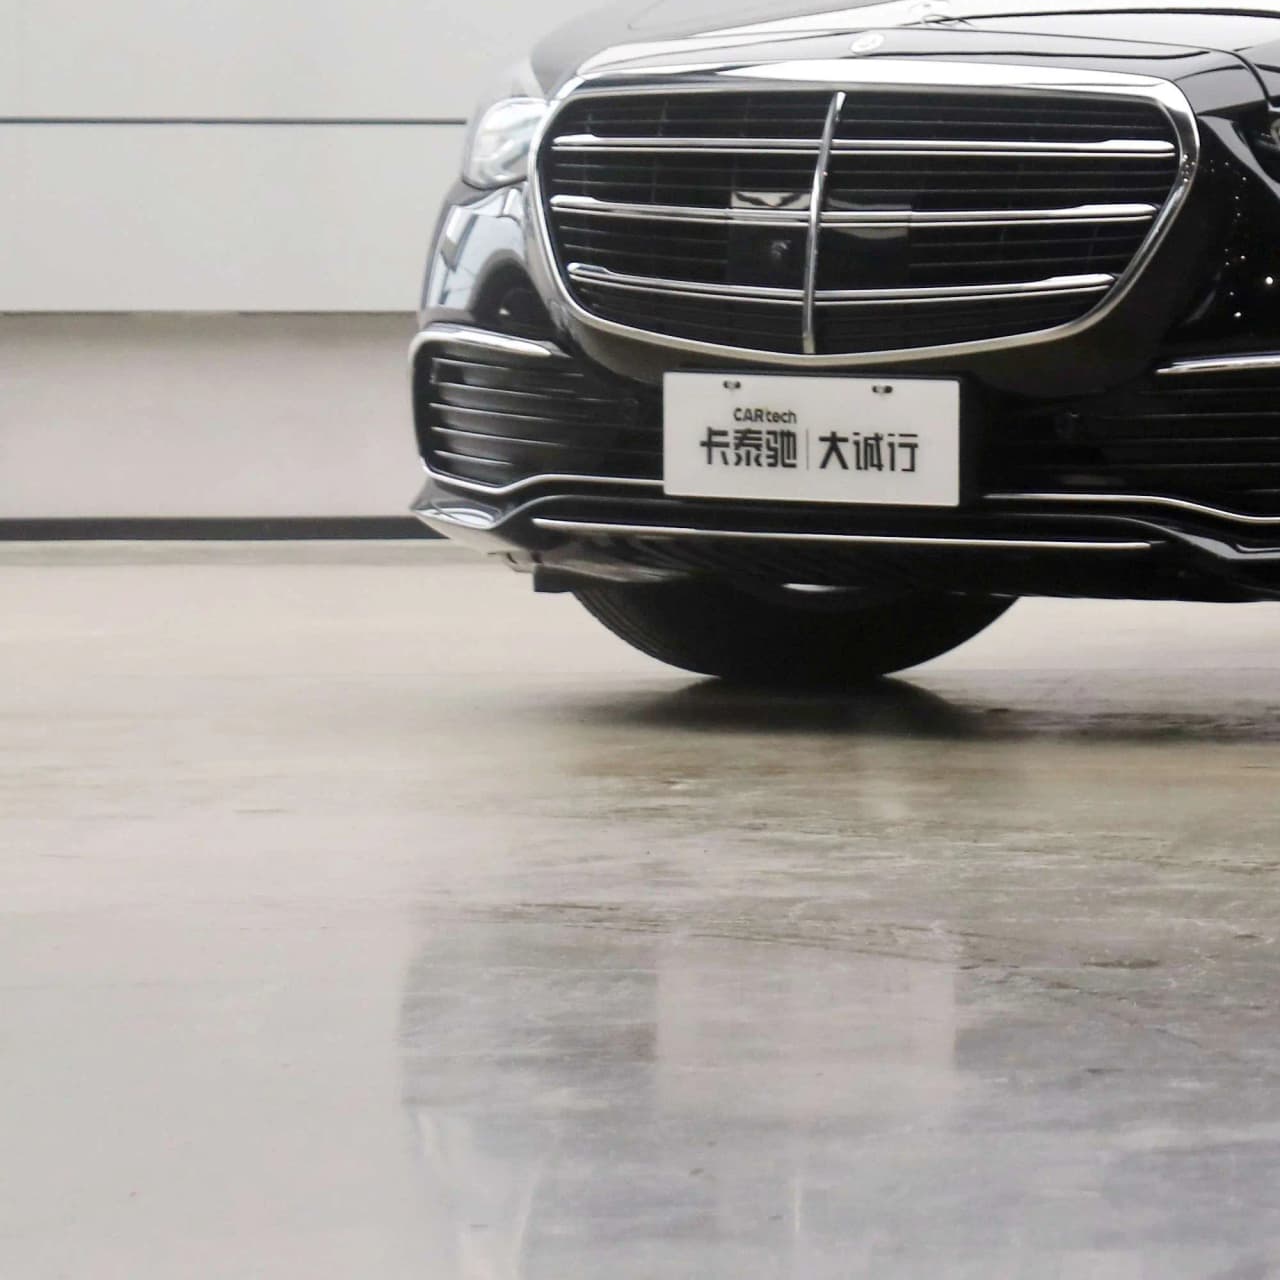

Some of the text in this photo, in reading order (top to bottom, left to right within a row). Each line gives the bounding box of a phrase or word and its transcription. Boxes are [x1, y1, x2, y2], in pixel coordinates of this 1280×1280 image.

[733, 407, 798, 424] CARtech
[700, 426, 919, 473] 卡泰驰 大诚行
